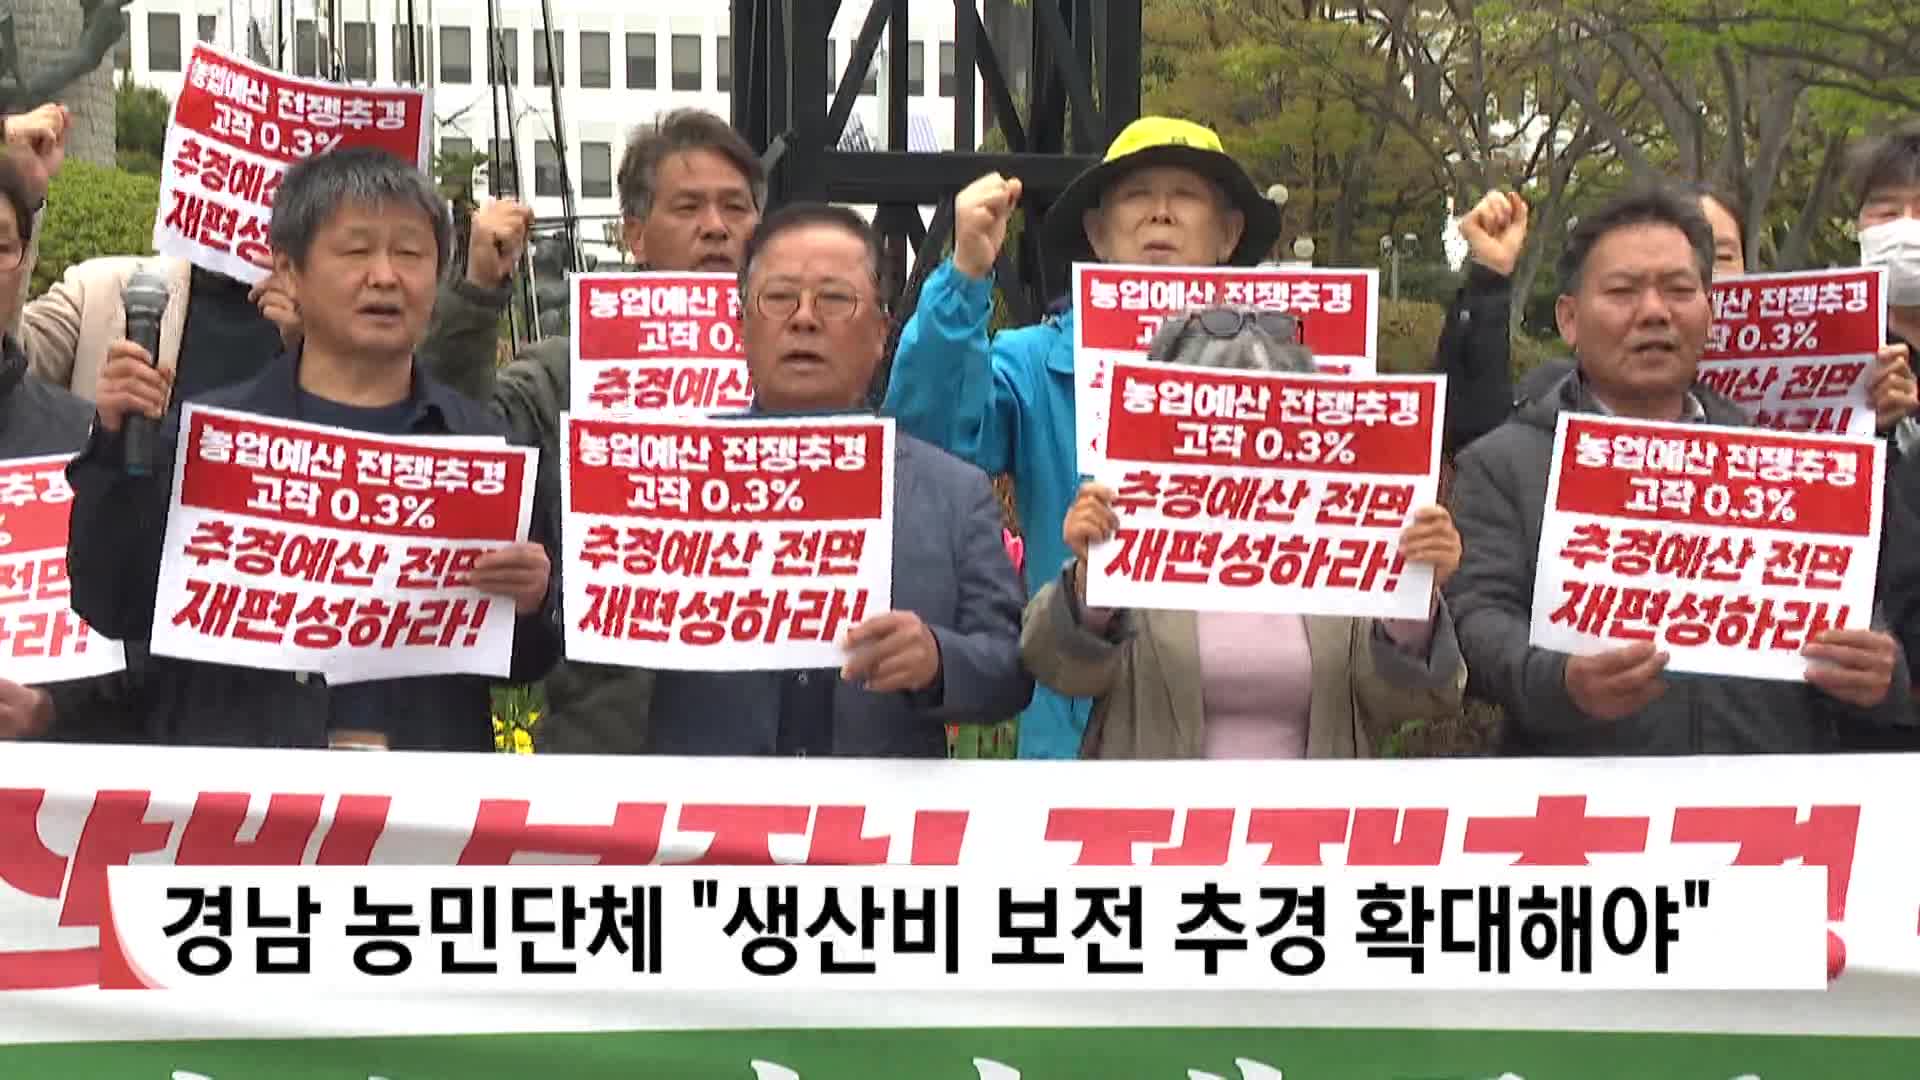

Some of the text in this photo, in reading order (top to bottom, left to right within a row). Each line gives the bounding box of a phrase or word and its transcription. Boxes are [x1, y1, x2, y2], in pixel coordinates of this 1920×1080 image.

[190, 57, 405, 130] 농업예산 전쟁추경
[210, 102, 254, 144] 고작
[589, 286, 718, 318] 농업예산
[1089, 278, 1352, 313] 농업예산 전쟁추경
[1760, 281, 1868, 318] 전쟁추경
[638, 320, 700, 352] 고작
[1737, 321, 1818, 350] 0.3%
[589, 366, 753, 409] 추경예산
[1122, 377, 1420, 426] 농업예산 전쟁추경
[1782, 363, 1866, 400] 전면
[200, 425, 507, 496] 농업예산 전쟁추경
[577, 430, 867, 472] 농업예산 전쟁추경
[1173, 422, 1356, 465] 고작 0.3%
[1576, 431, 1857, 487] 농업예산 전쟁추경
[246, 475, 437, 530] 고작 0.3%
[626, 475, 805, 514] 고작 0.3%
[1111, 470, 1414, 529] 추경예산 전면
[1626, 479, 1797, 523] 고작 0.3%
[183, 520, 389, 588] 추경예산
[579, 524, 867, 577] 추경예산 전면
[1104, 528, 1407, 592] 재편성하라!
[1560, 523, 1853, 590] 추경예산 전면
[170, 577, 491, 649] 재편성하라!
[578, 584, 869, 646] 재편성하라!
